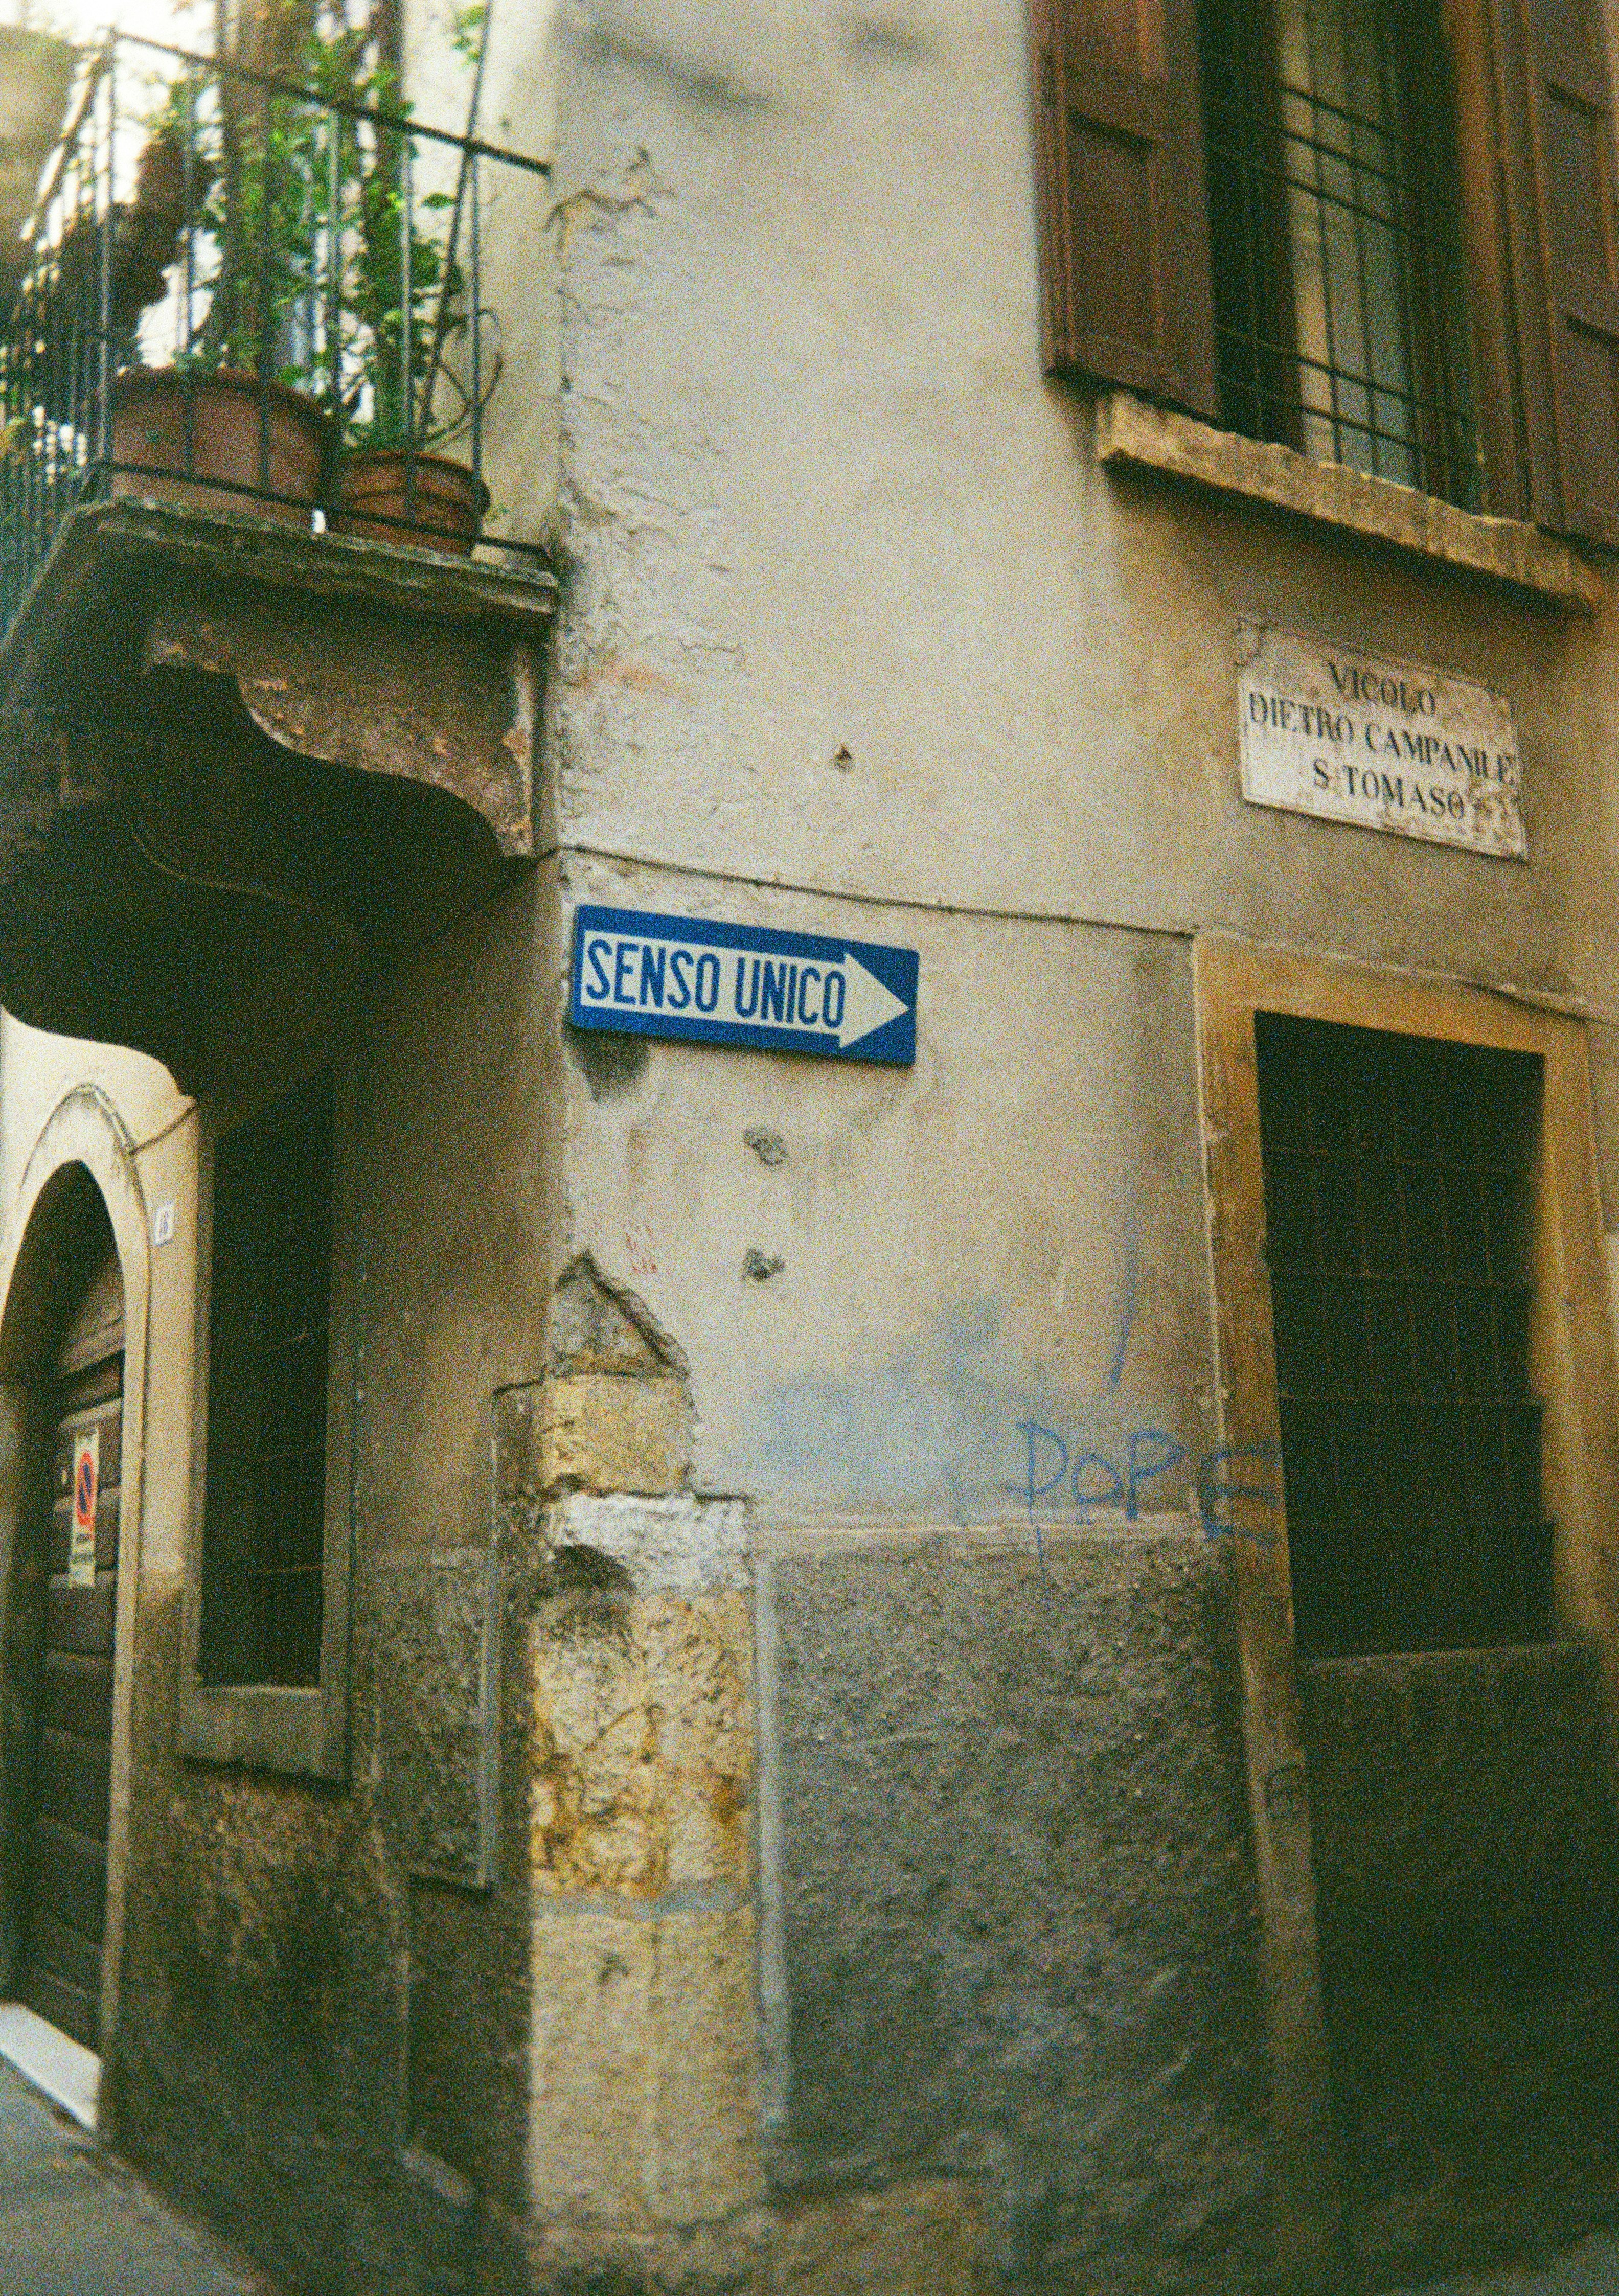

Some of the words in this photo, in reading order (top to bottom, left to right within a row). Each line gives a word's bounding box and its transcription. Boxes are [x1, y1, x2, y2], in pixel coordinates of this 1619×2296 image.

[1329, 662, 1435, 716] VICOLO
[1249, 692, 1354, 745] DIETRO
[1365, 722, 1516, 785] CAMPANILE
[1342, 765, 1464, 818] TOMASO
[586, 939, 720, 1013] SENSO
[734, 956, 846, 1028] UNICO
[1006, 1420, 1283, 1541] DOPE
